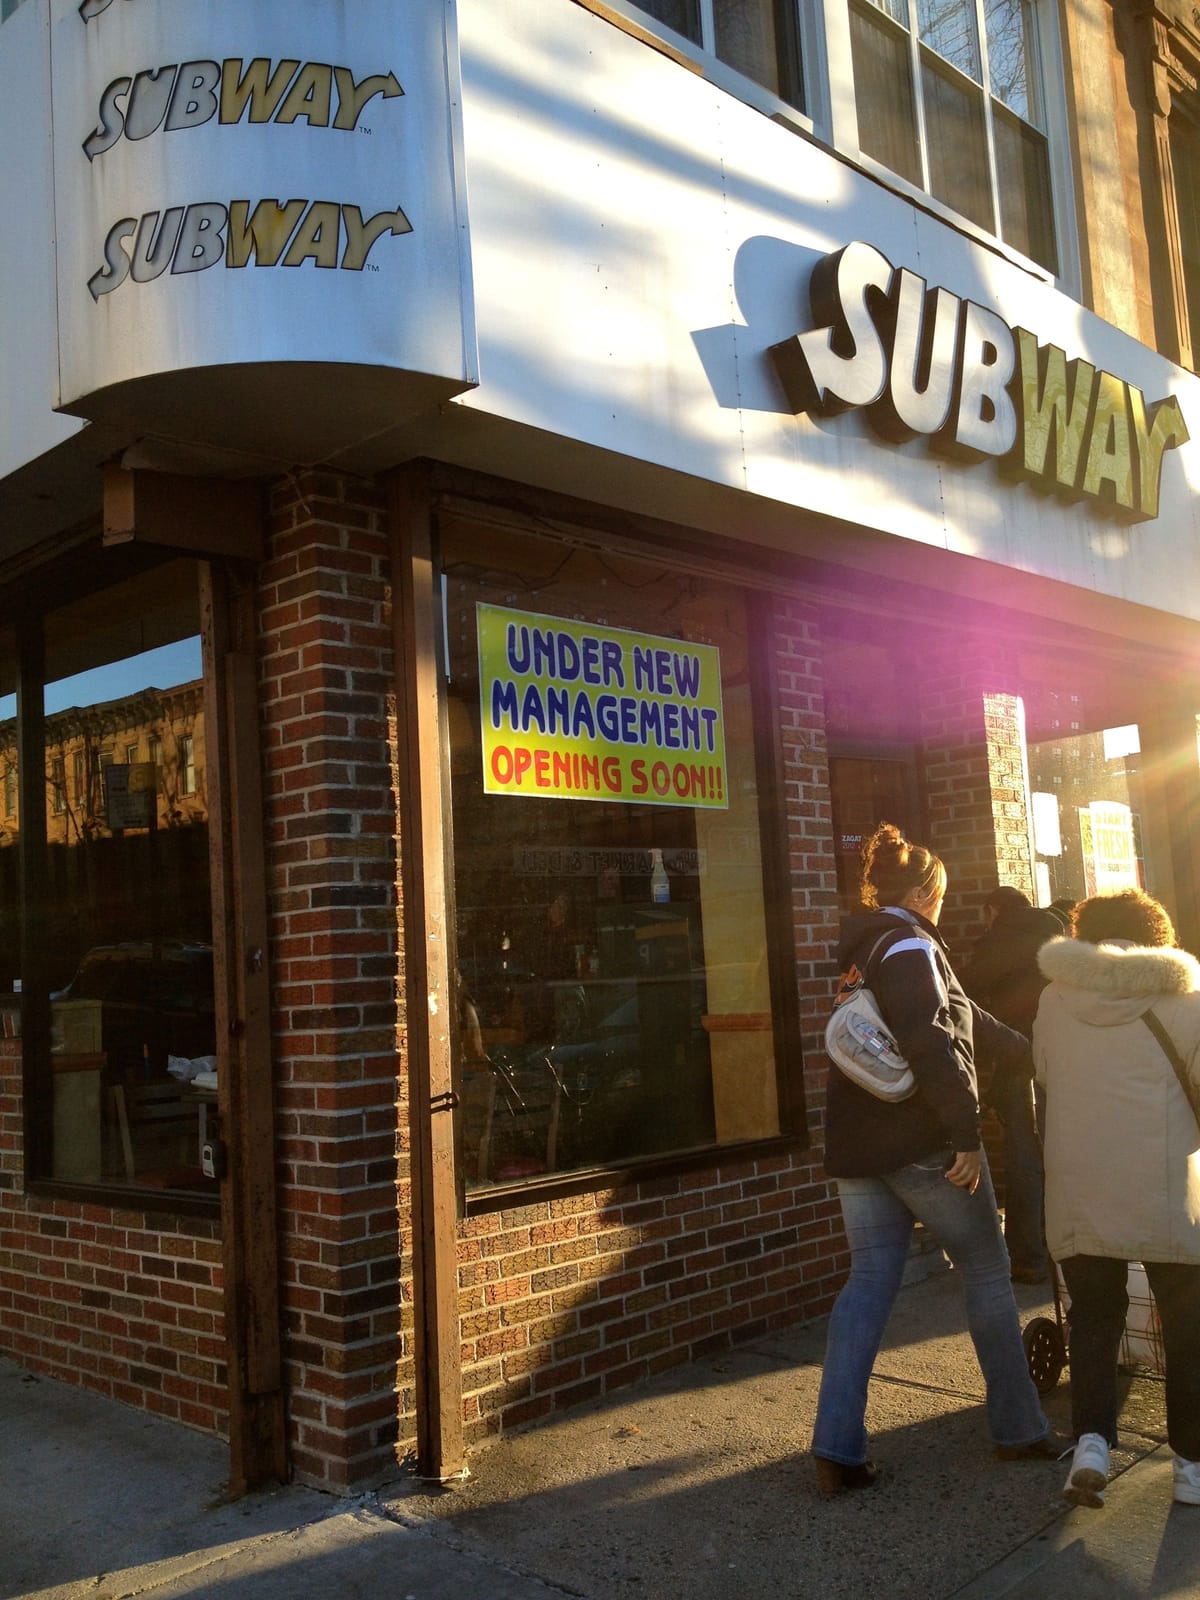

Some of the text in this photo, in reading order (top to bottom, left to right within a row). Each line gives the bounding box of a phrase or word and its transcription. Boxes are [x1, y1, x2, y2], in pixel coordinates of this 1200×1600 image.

[82, 57, 405, 163] SUBWAY
[87, 198, 413, 303] SUBWAY
[794, 241, 1191, 519] SUBWAY
[506, 622, 701, 699] UNDER NEW
[490, 678, 719, 753] MANAGEMENT
[490, 745, 723, 800] OPENING SOON!!
